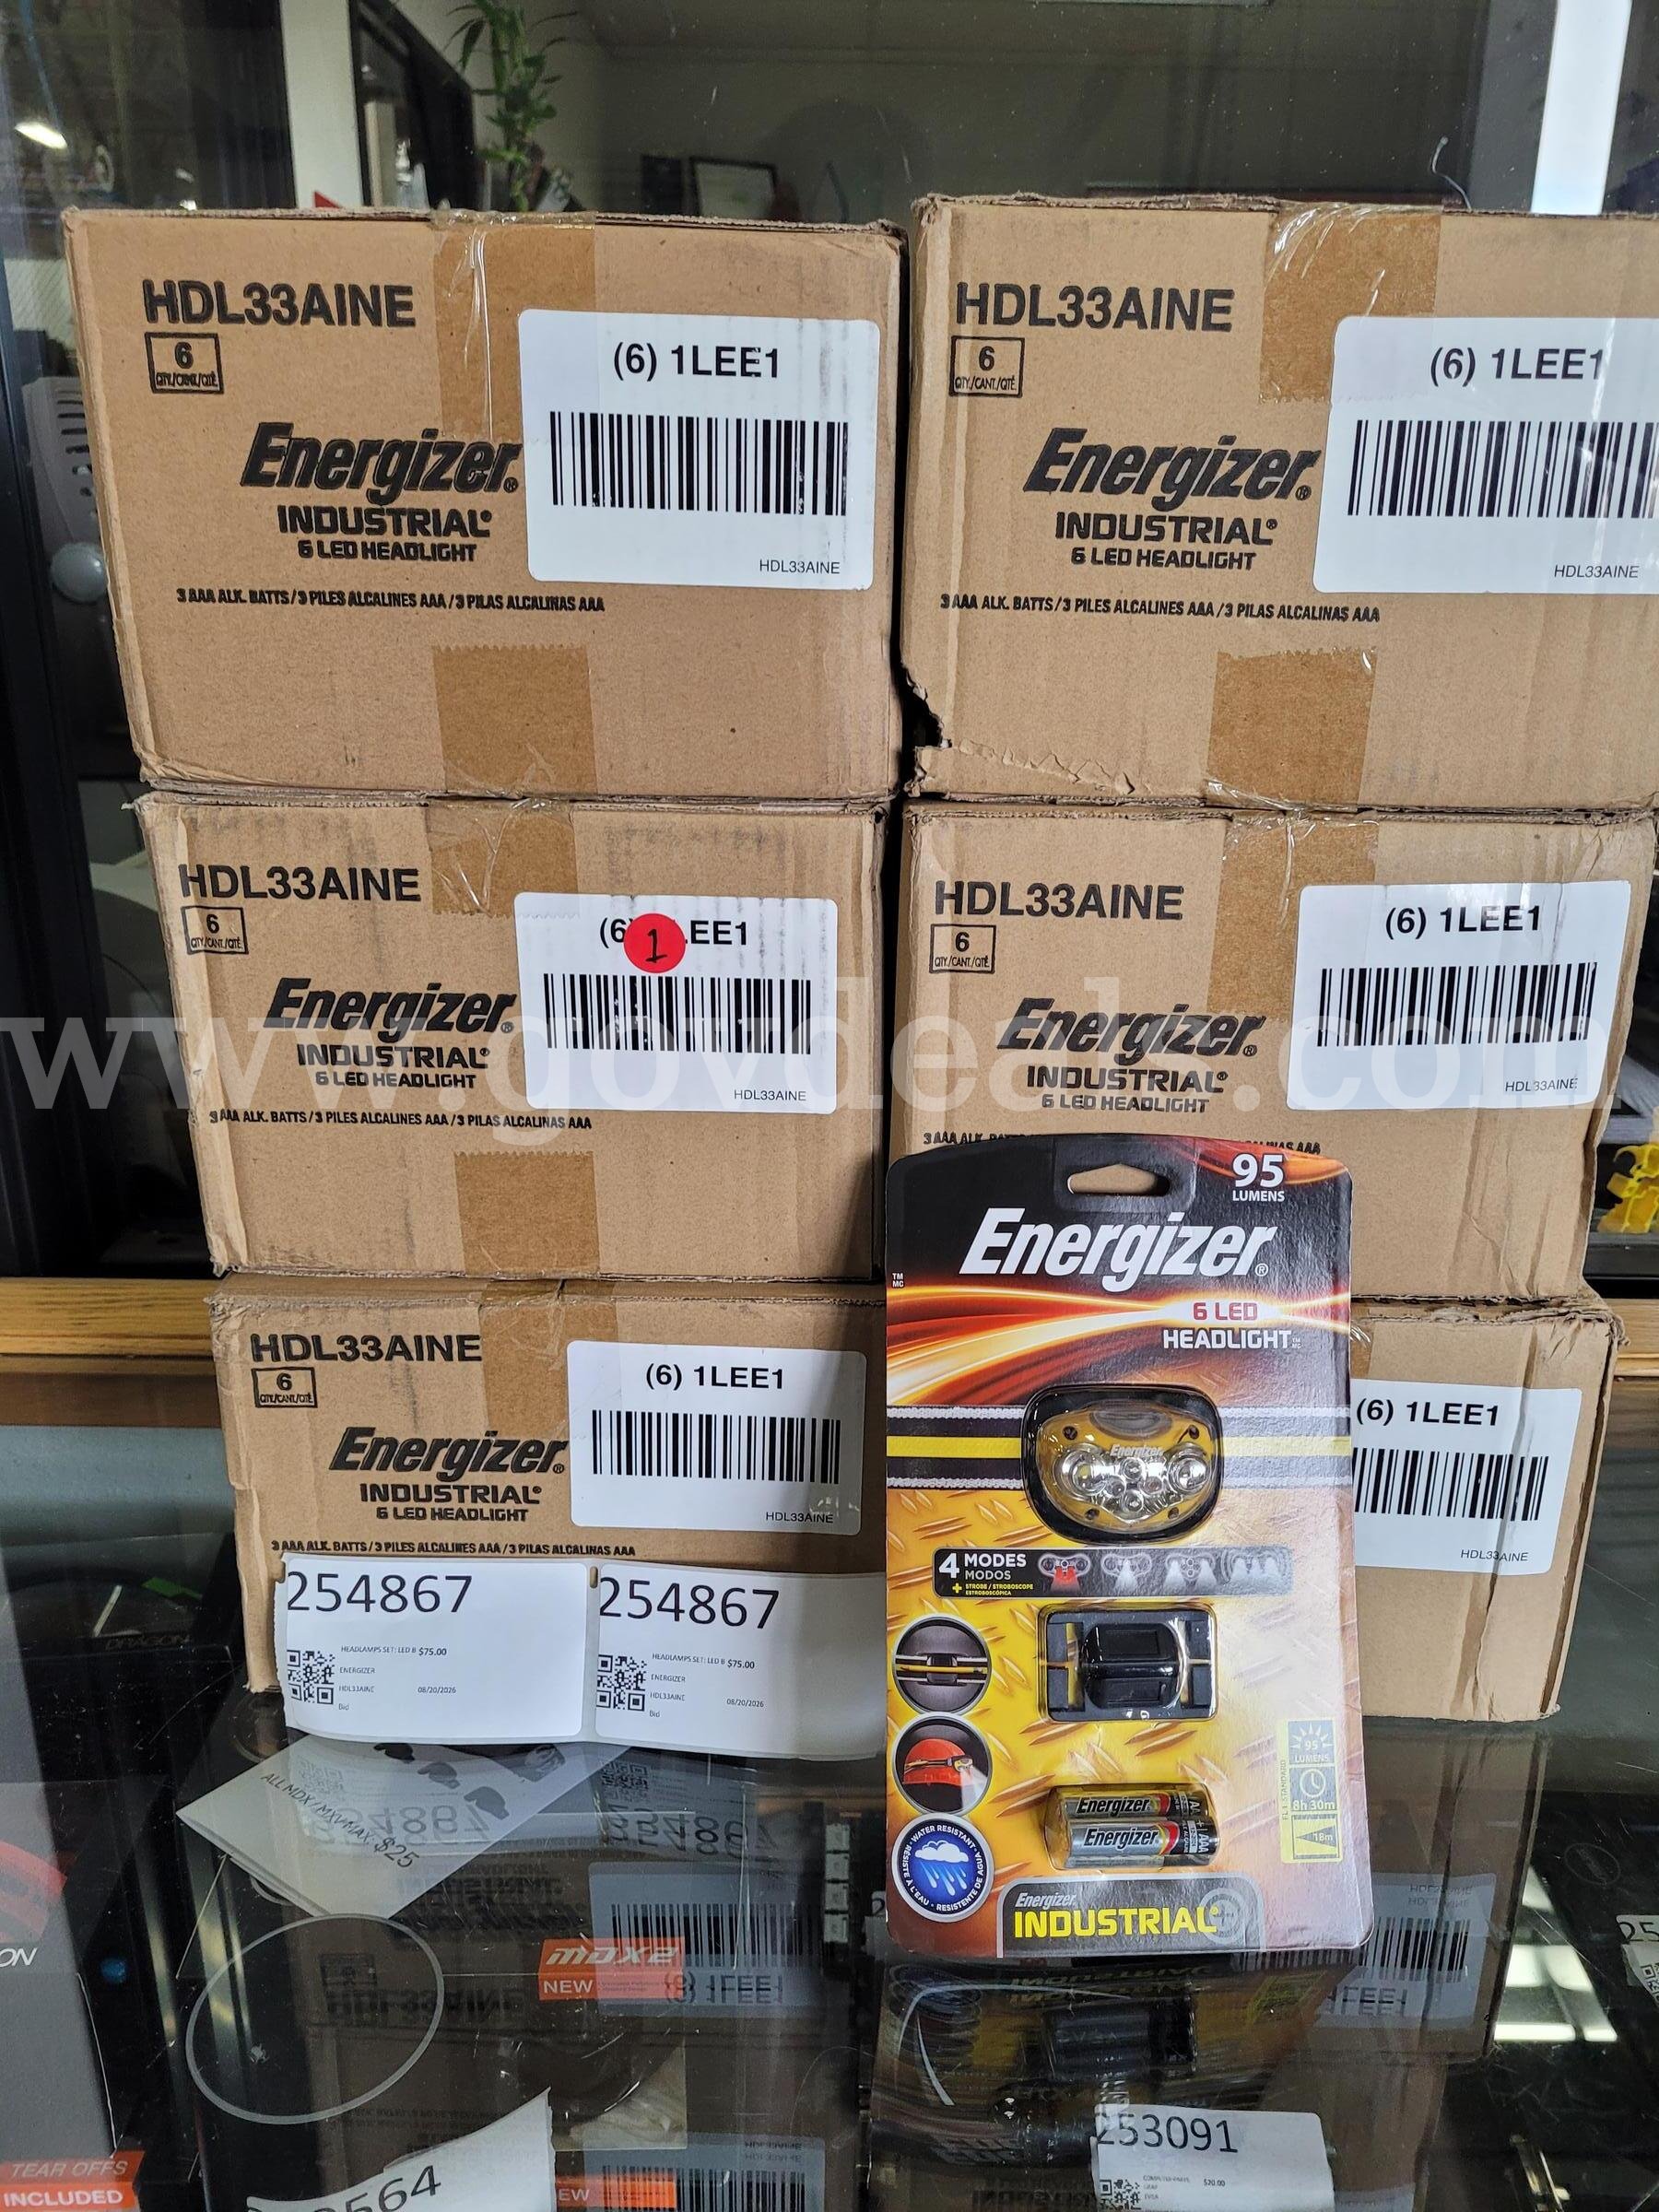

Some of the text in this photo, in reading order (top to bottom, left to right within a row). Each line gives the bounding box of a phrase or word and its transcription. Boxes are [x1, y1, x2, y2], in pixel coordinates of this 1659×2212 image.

[143, 279, 415, 326] HDL33AINE
[956, 282, 1234, 332] HDL33AINE
[174, 342, 194, 368] 6
[614, 343, 779, 382] (6) 1LEE1
[978, 346, 994, 371] 6
[1430, 347, 1606, 387] (6) 1LEE1
[298, 542, 477, 561] 6 LED HEADLIGHT
[1071, 548, 1256, 570] 6 LED HEADLIGHT
[759, 559, 840, 574] HDL33AINE
[1554, 564, 1639, 578] HDL33AINE
[177, 588, 604, 612] 3 AAA ALK. PILES ALCALINES PILAS ALCALINAS AAA
[941, 594, 1381, 622] 3 AAA ALK. PILES ALCALINES PILAS ALCALINAS AAA
[179, 865, 421, 901] HDL33AINE
[935, 880, 1183, 920] HDL33AINE
[206, 913, 219, 934] 6
[1385, 905, 1540, 939] (6) 1LEE1
[645, 928, 667, 963] 1
[955, 932, 970, 953] 6
[315, 1071, 477, 1088] 6 LED HEADLIGHT
[1505, 1077, 1578, 1092] HDL33AINE
[734, 1089, 806, 1101] HDL33AINE
[1042, 1094, 1209, 1112] 6 LED HEADLIGHT
[209, 1111, 592, 1130] 3 AAA ALK. PILES ALCALINES PILAS ALCALINAS AAA
[924, 1132, 957, 1145] 3 AAA
[1231, 1153, 1285, 1187] 95
[1232, 1190, 1285, 1202] LUMENS
[1193, 1302, 1258, 1321] 6 LED
[251, 1334, 482, 1362] HDL33AINE
[276, 1373, 292, 1392] 6
[646, 1363, 782, 1390] (6) 1LEE1
[1357, 1398, 1499, 1426] (6) 1LEE1
[376, 1508, 529, 1522] 6 LED HEADLIGHT
[766, 1511, 833, 1524] HDL33AINE
[272, 1541, 636, 1558] 3 AAA ALK. PILES ALCALINES PILAS ALCALINAS AAA
[1461, 1549, 1528, 1561] HDL33AINE
[939, 1553, 959, 1578] 4
[964, 1553, 1027, 1567] MODES
[965, 1571, 1011, 1580] MODOS
[288, 1571, 473, 1613] 254867
[600, 1577, 779, 1630] 254867
[418, 1647, 447, 1656] $75.00
[653, 1653, 691, 1663] HEADLAMPS
[727, 1660, 755, 1669] $75.00
[1305, 1741, 1318, 1750] 95
[1293, 1800, 1335, 1810] 8h 30m
[911, 1825, 975, 1849] WATER RESISTANT
[1313, 1832, 1333, 1841] 18m
[374, 1837, 419, 1868] $25
[936, 1852, 983, 1912] RESISTENTE DE AGUA
[544, 1980, 593, 1994] NEW
[1096, 2112, 1238, 2153] 253091
[10, 2161, 128, 2177] TEAR OFFS
[4, 2190, 124, 2207] INCLUDED
